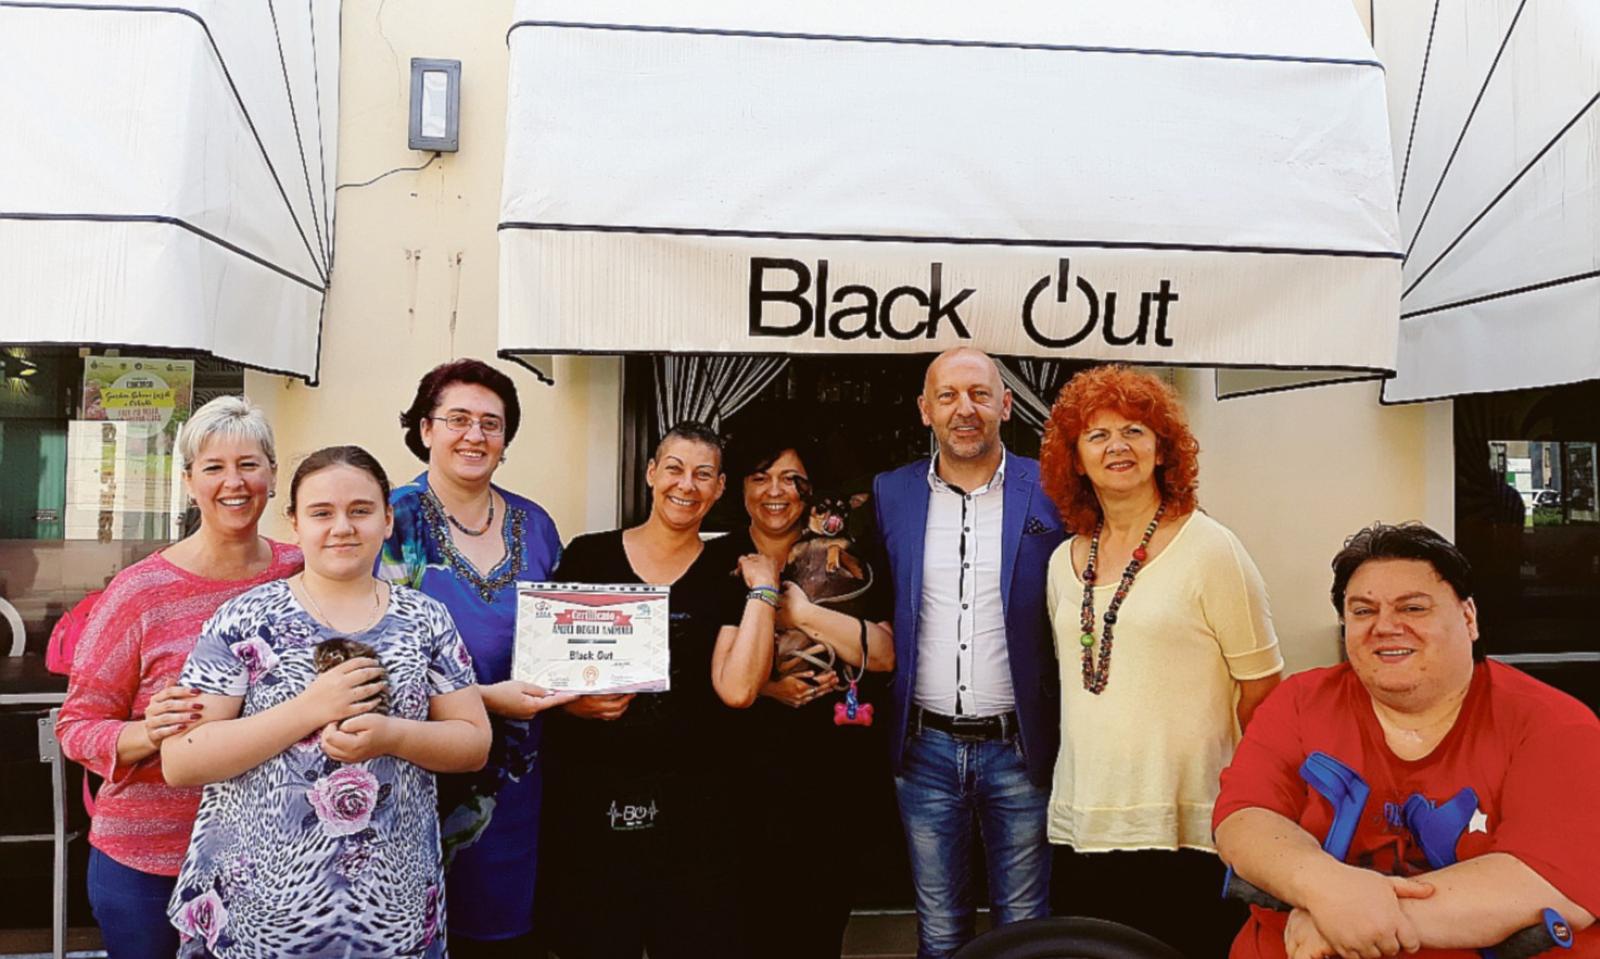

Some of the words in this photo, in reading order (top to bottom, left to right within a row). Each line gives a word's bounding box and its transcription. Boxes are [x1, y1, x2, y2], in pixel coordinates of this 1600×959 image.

[748, 256, 976, 341] Black
[1021, 257, 1179, 348] Out
[571, 610, 615, 621] Certificato
[576, 624, 599, 635] DEGLI
[569, 651, 594, 661] Black
[596, 651, 614, 661] Out
